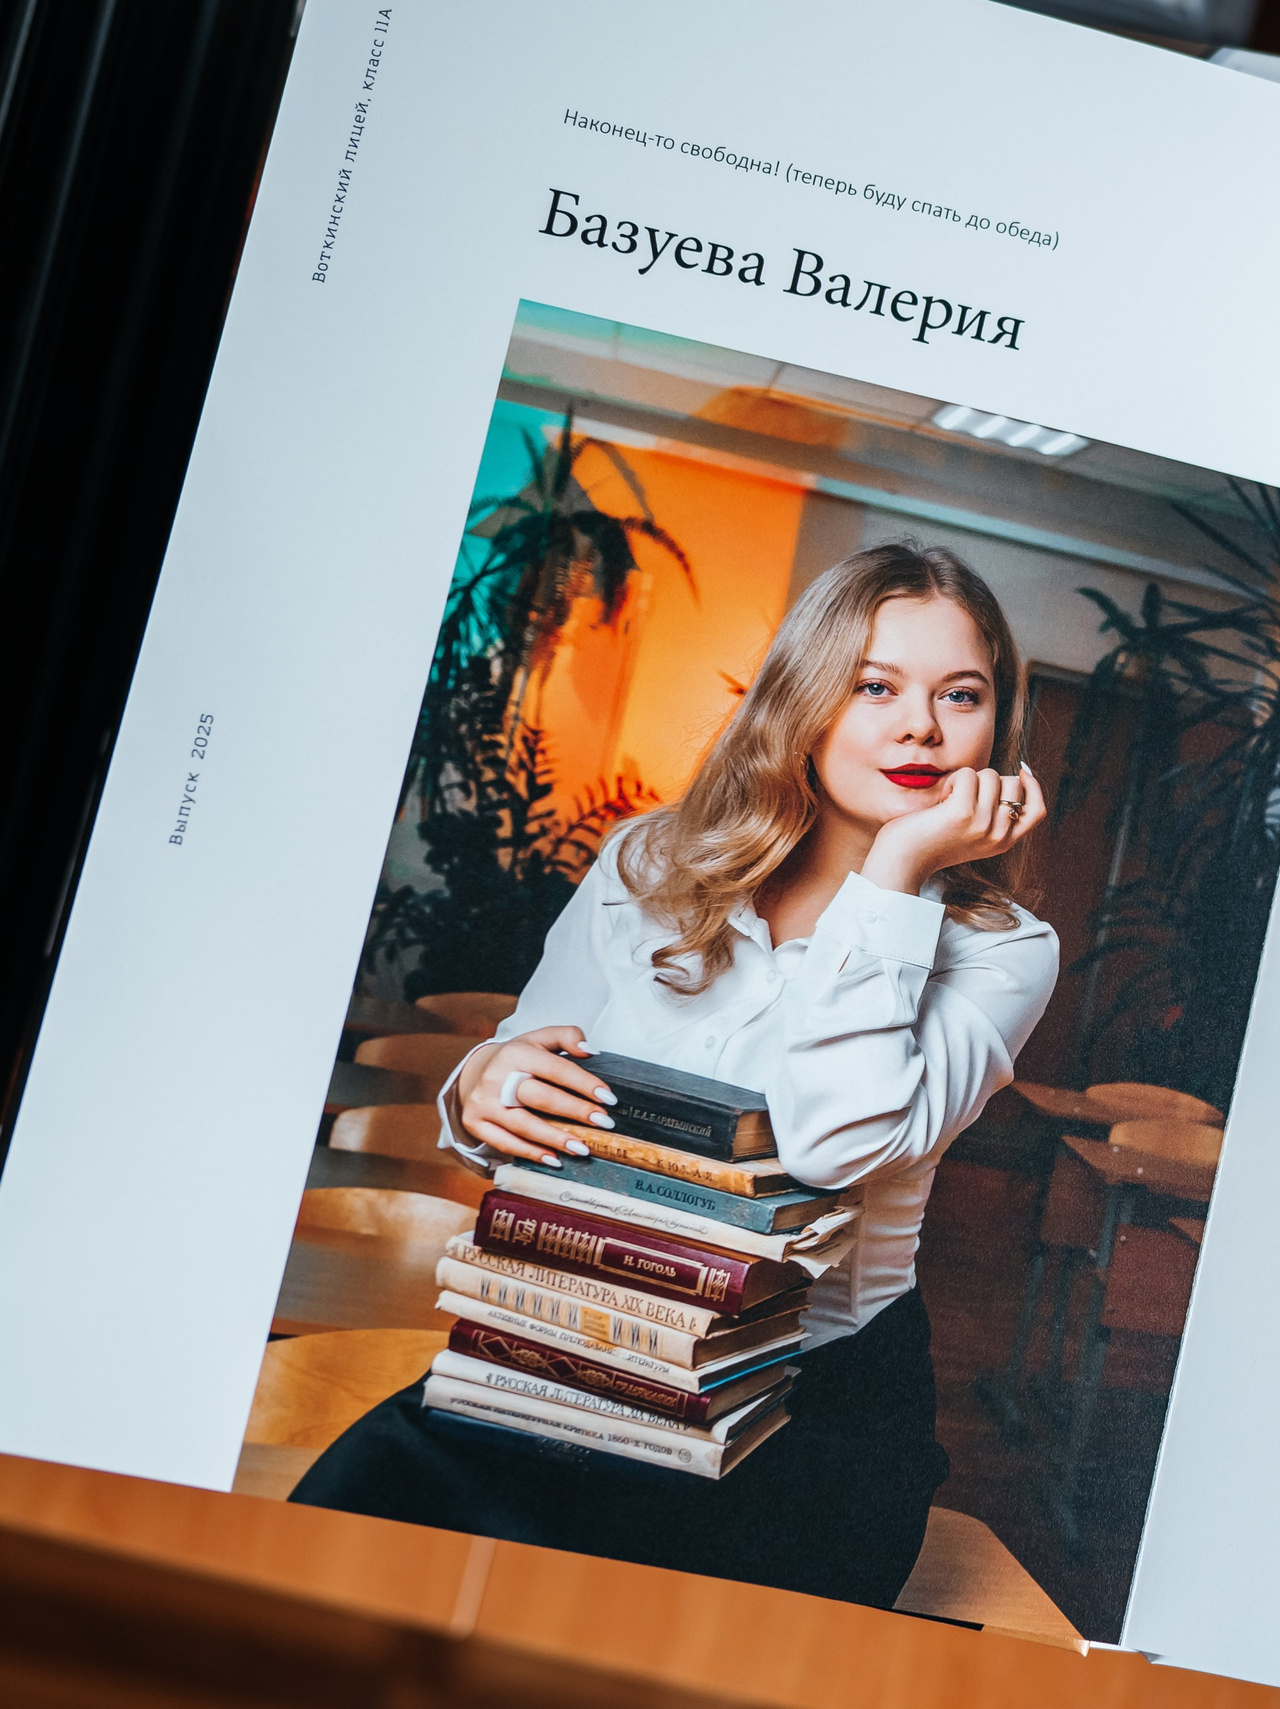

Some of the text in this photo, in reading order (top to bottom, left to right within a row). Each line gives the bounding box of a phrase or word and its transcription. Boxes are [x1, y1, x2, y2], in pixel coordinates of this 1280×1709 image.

[311, 168, 353, 284] Воткинский
[344, 98, 371, 163] лицей,
[362, 38, 385, 91] класс
[564, 108, 1060, 252] Наконец-то свободна! (теперь буду спать до обеда)
[539, 187, 1026, 351] Базуева Валерия
[168, 713, 214, 846] Выпуск 2025
[463, 1244, 527, 1276] РУССКАЯ
[529, 1267, 618, 1306] ЛИТЕРАТУРА
[622, 1293, 645, 1312] XIX
[646, 1301, 687, 1328] ВЕКА
[637, 1258, 677, 1278] ГОГОЛЬ
[494, 1373, 549, 1397] РУССКАЯ
[550, 1386, 626, 1415] ЛИТЕРАТУРА
